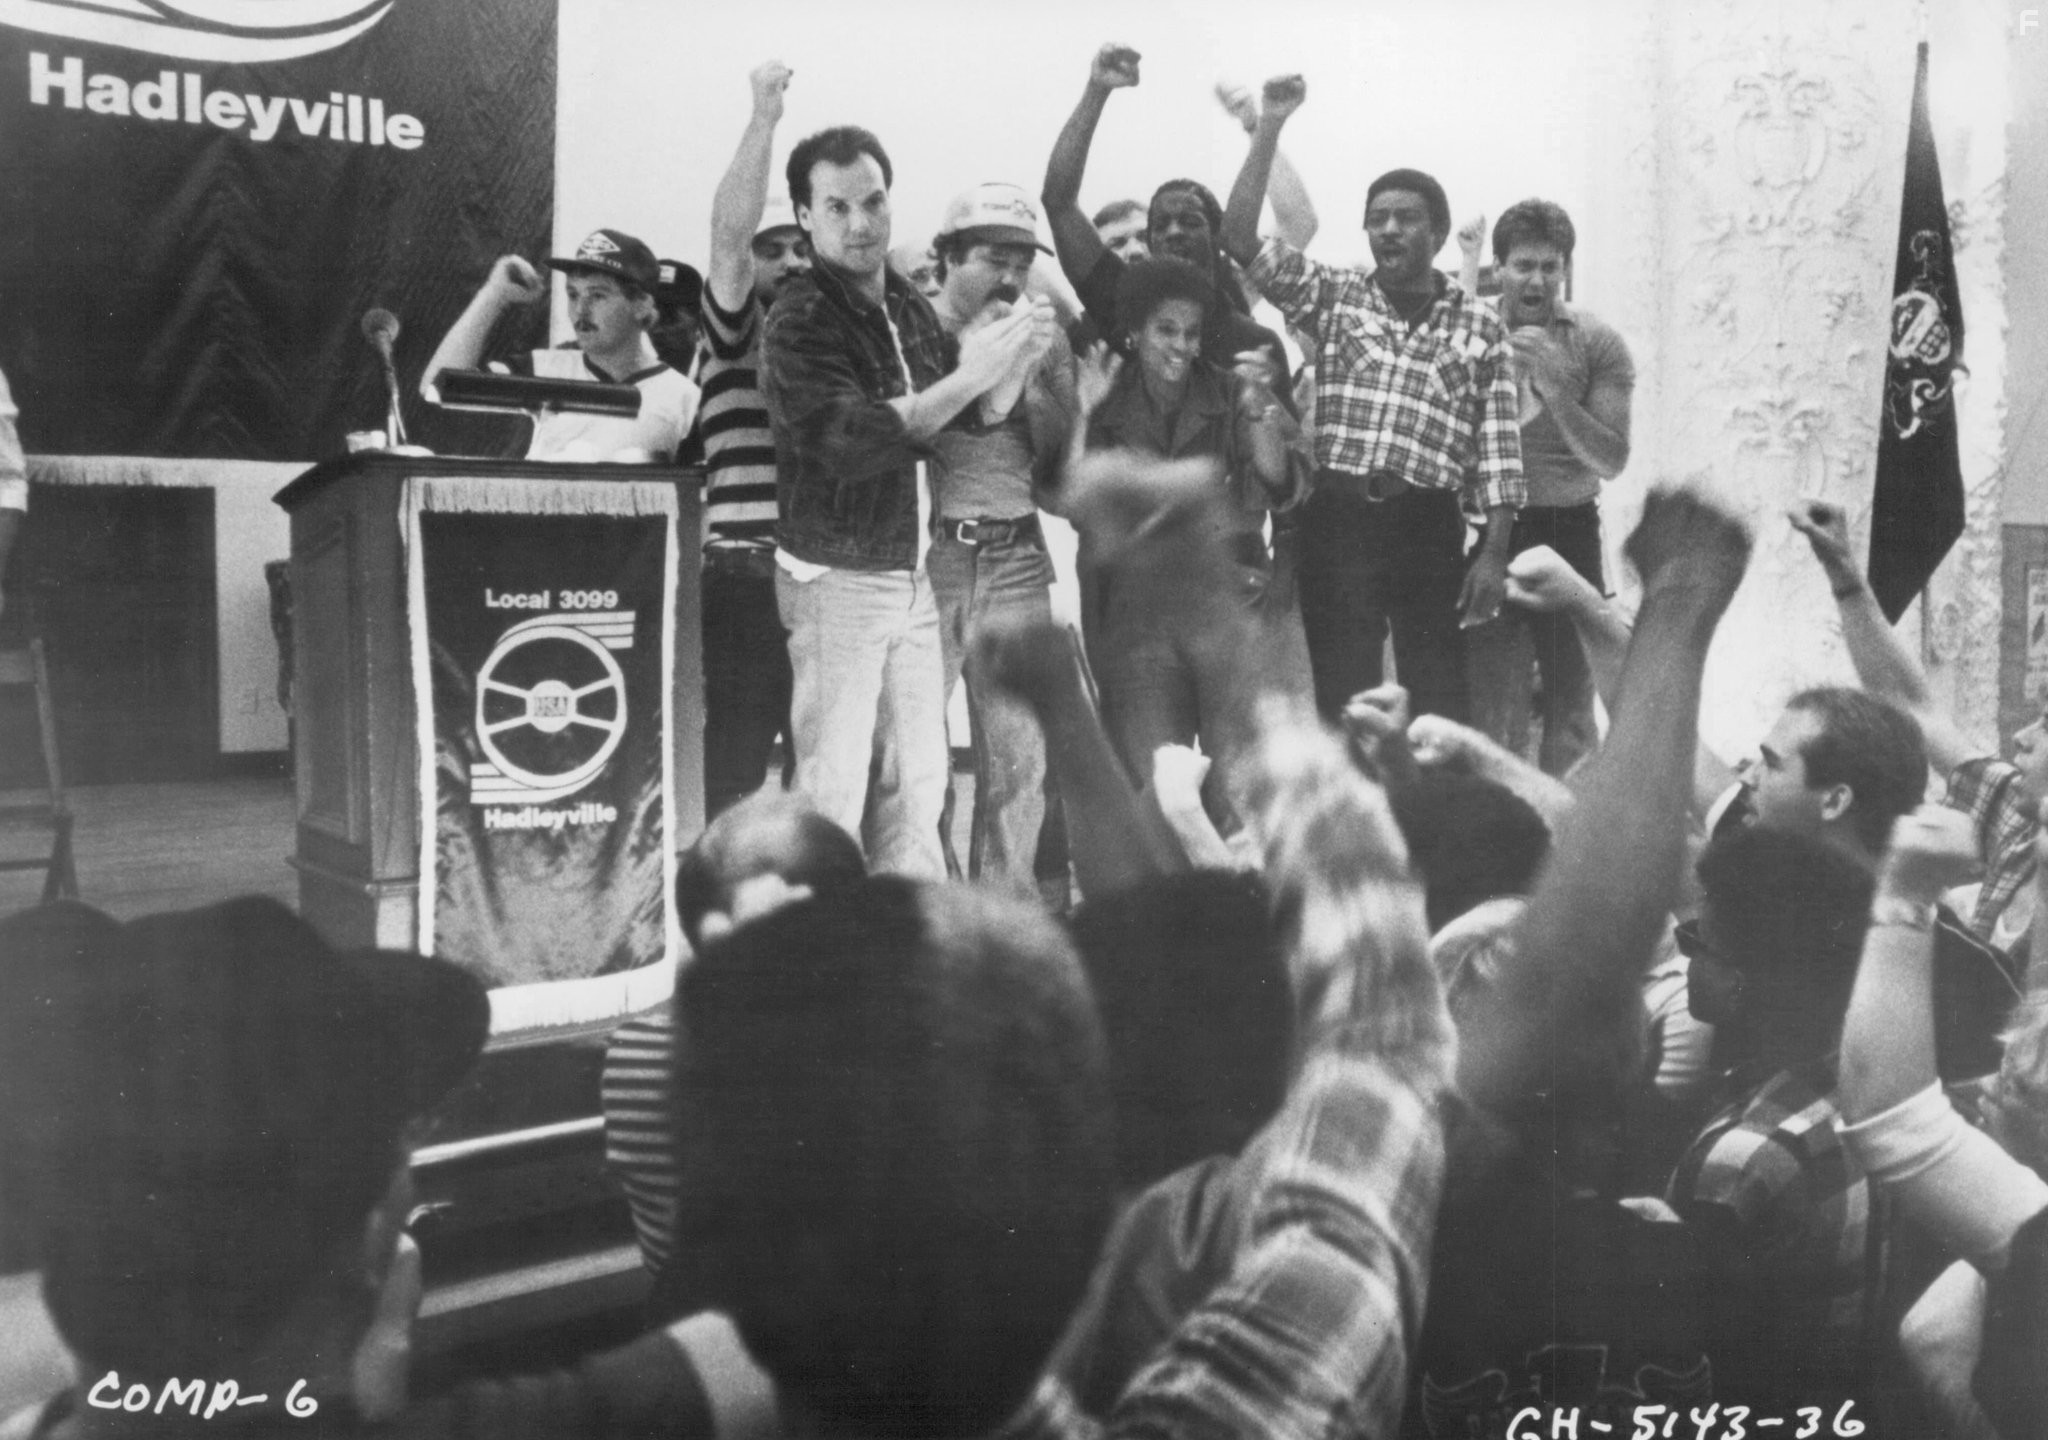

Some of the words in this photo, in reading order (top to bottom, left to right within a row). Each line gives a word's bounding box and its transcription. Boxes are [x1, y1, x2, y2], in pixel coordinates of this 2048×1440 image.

[28, 51, 426, 150] Hadleyville
[485, 588, 551, 609] Local
[559, 590, 619, 609] 3099
[484, 803, 617, 830] Hadleyville
